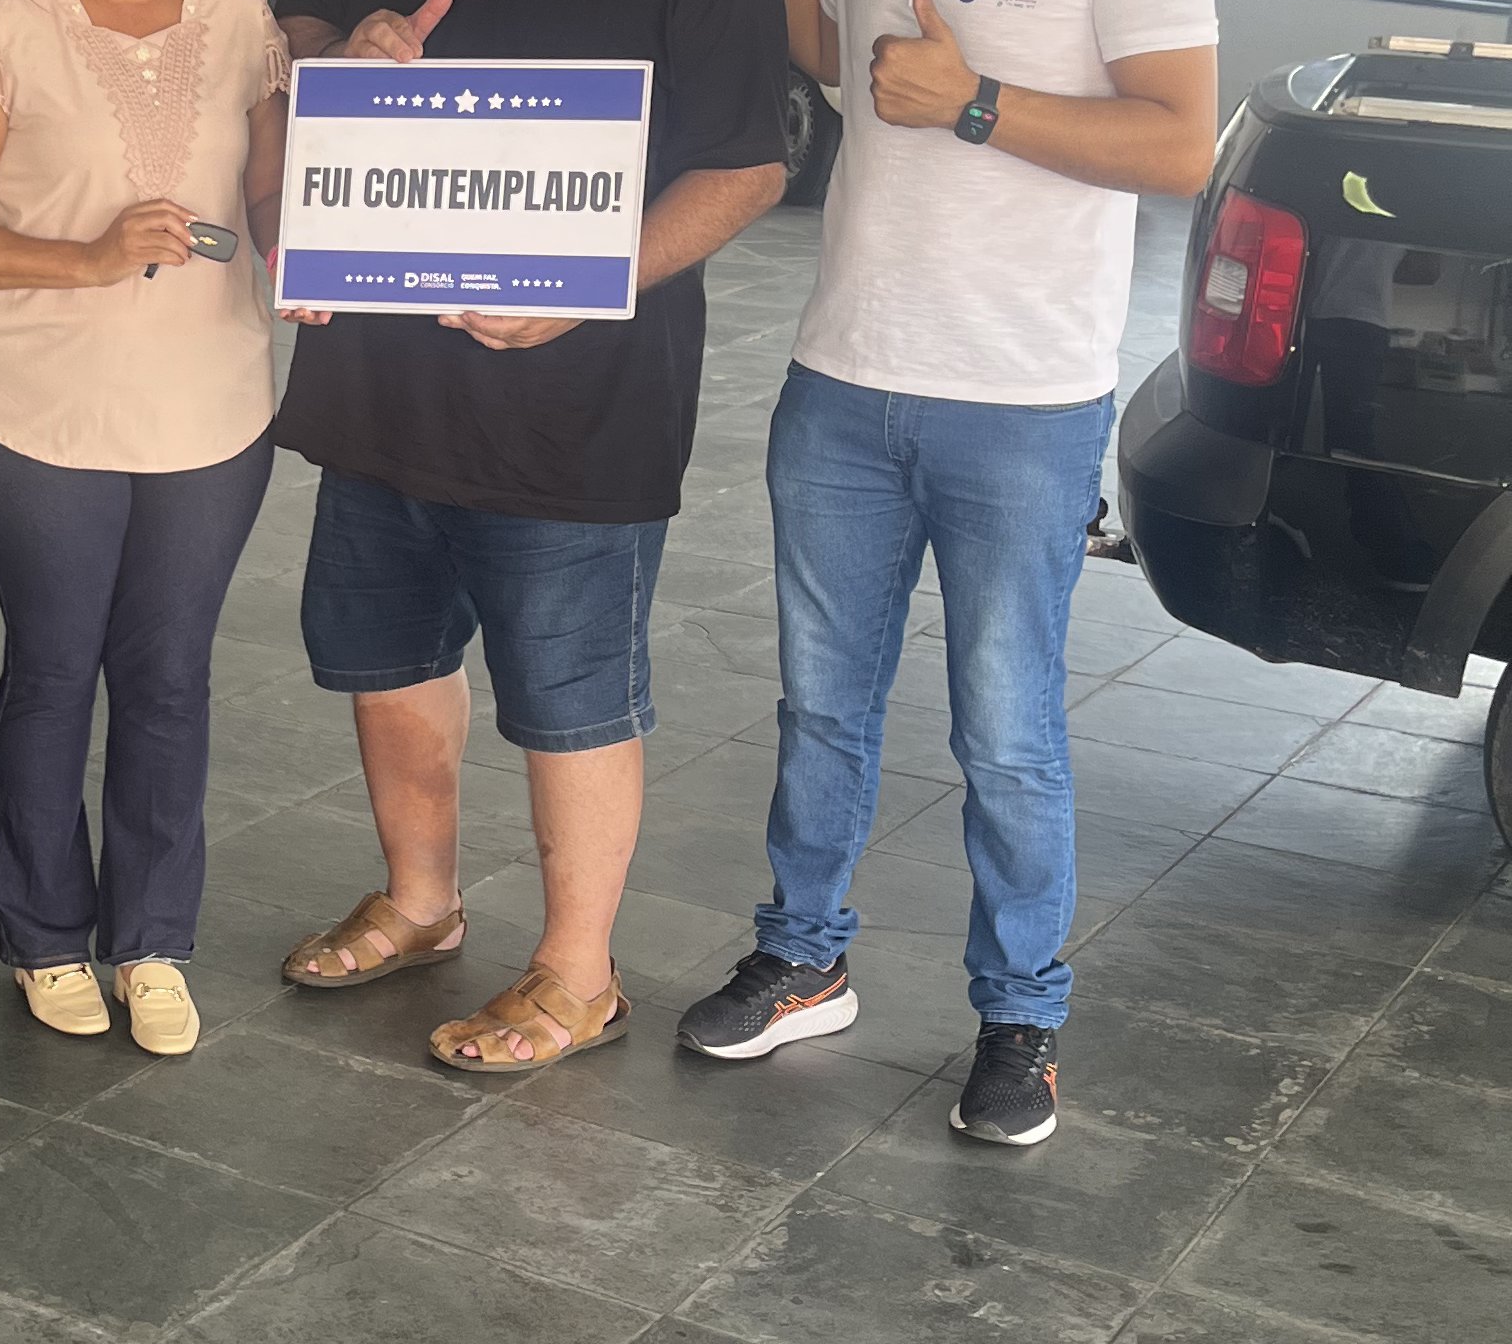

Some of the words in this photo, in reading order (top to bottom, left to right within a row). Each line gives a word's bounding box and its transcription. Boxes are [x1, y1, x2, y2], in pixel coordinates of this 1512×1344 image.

[302, 166, 353, 208] FUI
[363, 167, 624, 214] CONTEMPLADO!
[420, 272, 455, 282] DISAL
